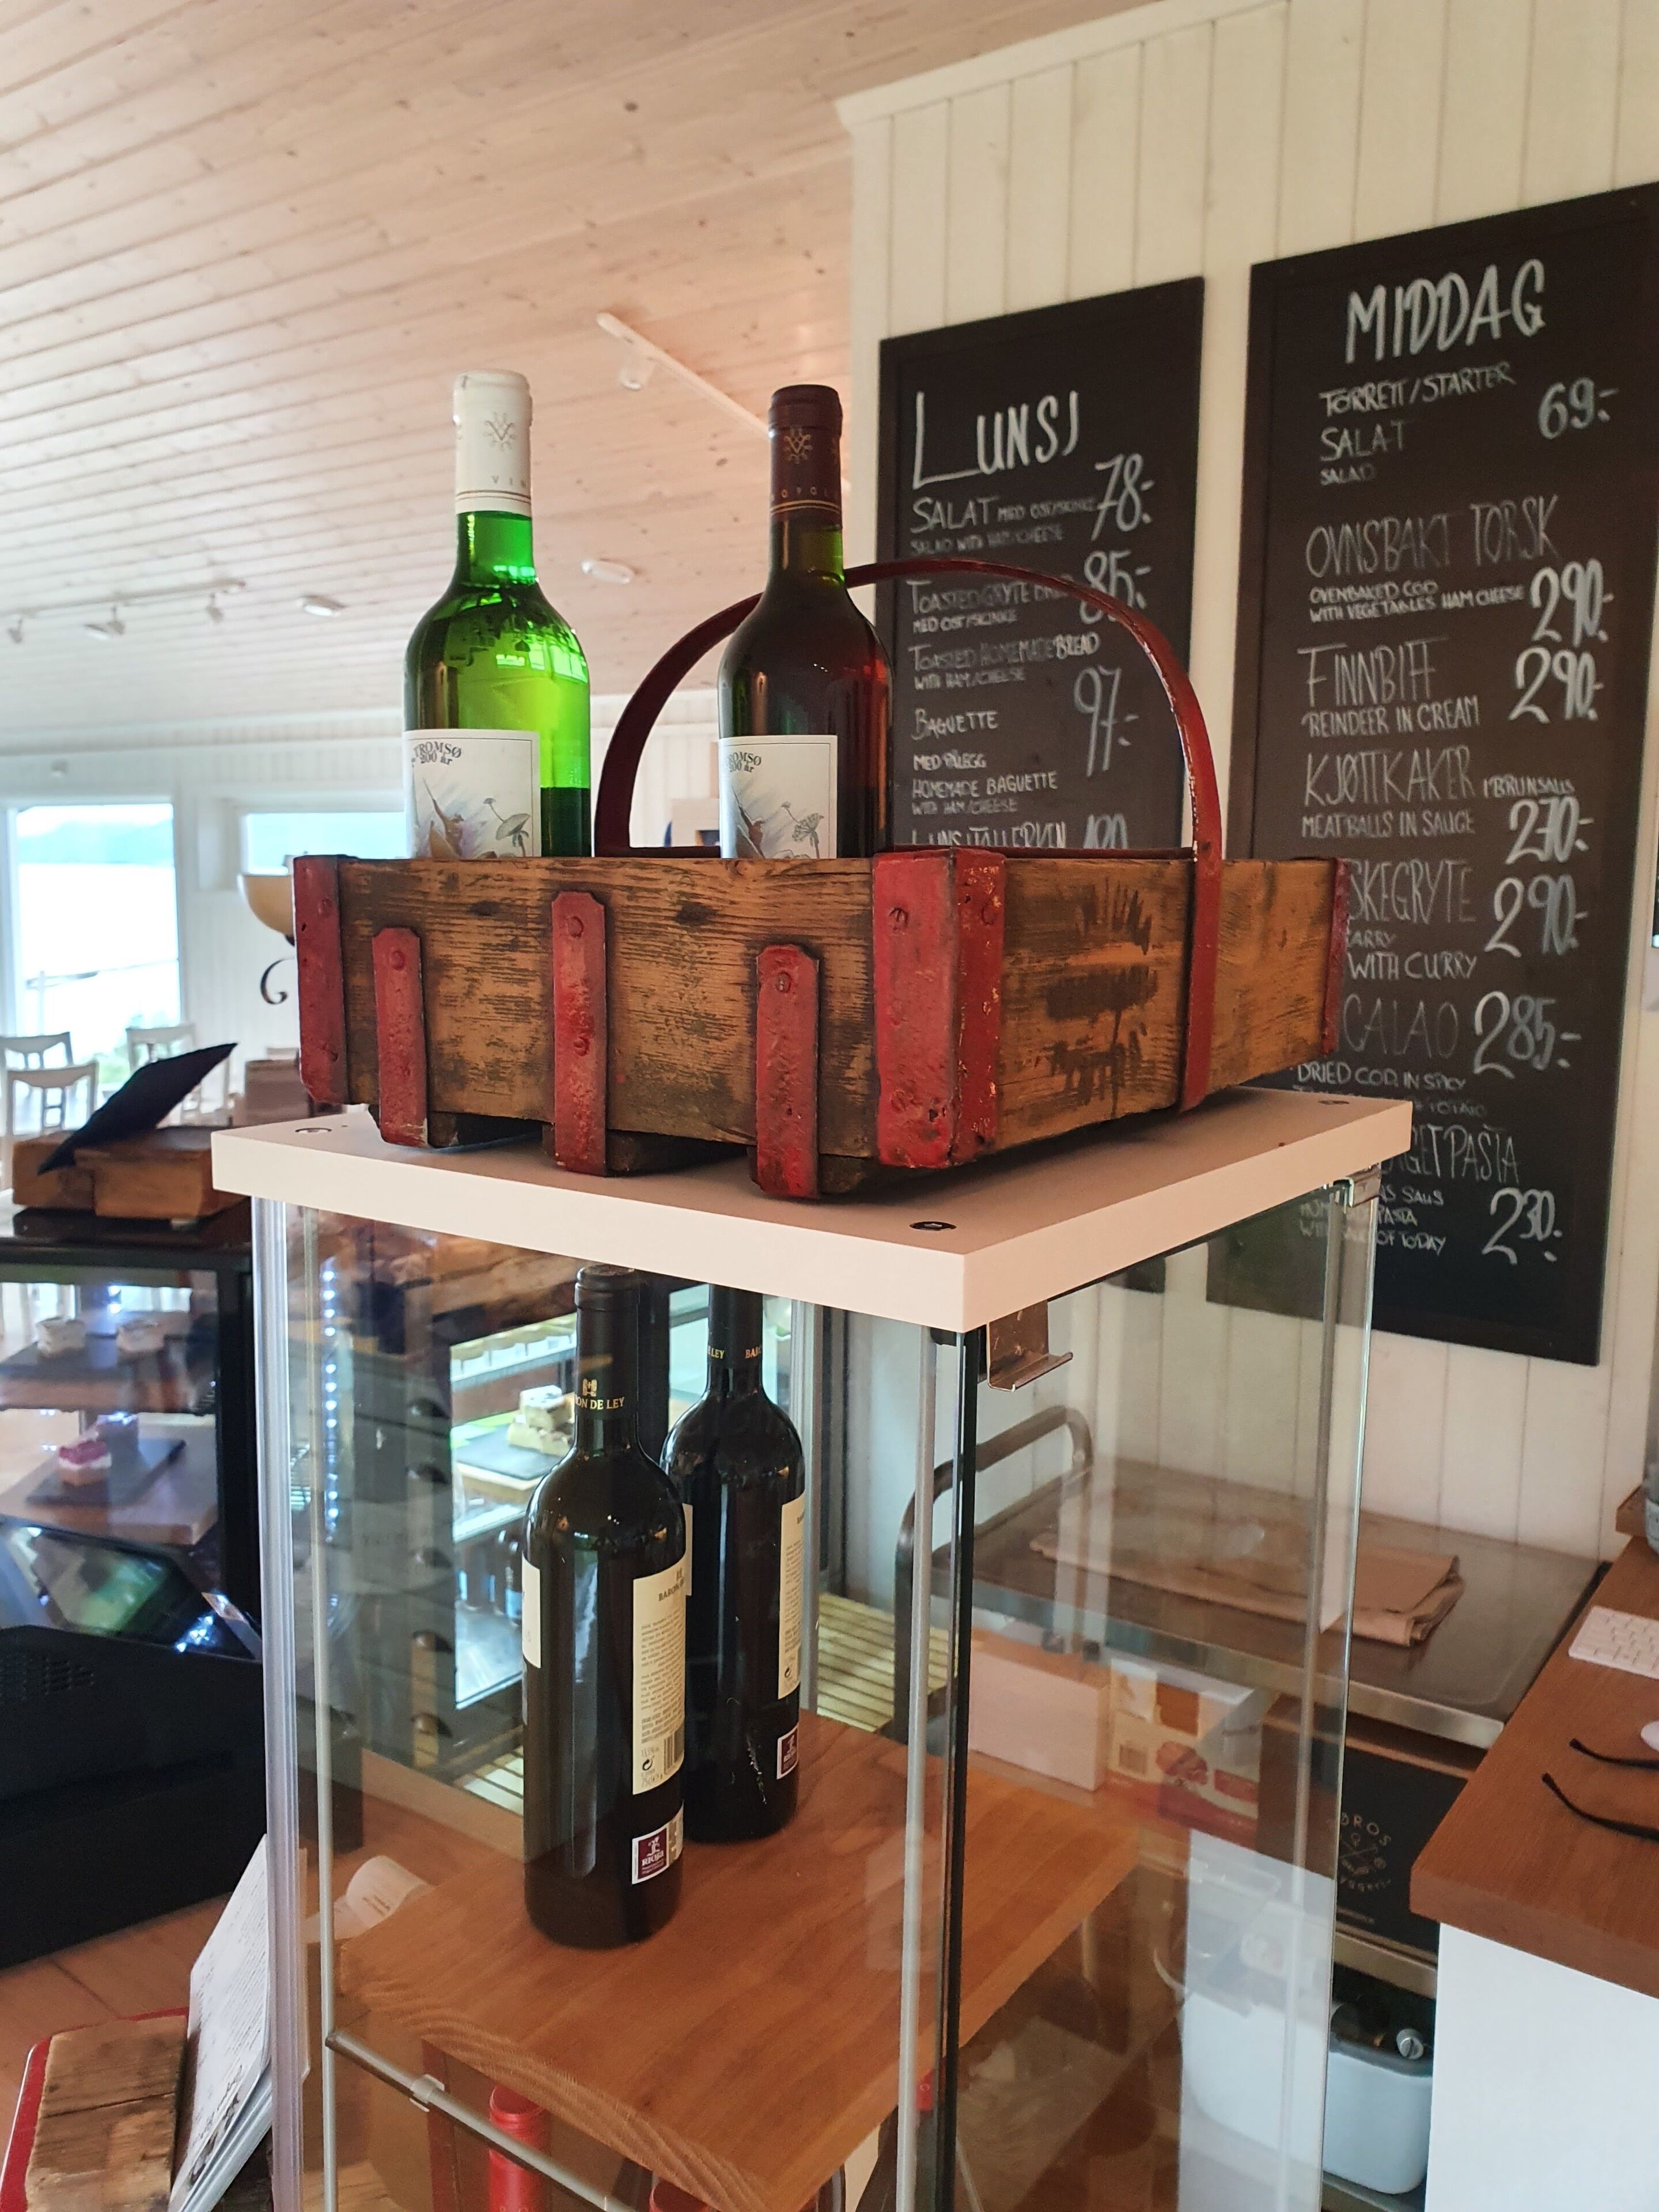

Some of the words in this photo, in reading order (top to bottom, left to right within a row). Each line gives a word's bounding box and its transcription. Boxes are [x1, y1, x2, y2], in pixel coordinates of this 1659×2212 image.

[1346, 259, 1546, 364] MIDDAG
[912, 390, 1080, 490] LUNSJ
[1320, 420, 1406, 461] SALAT
[1320, 463, 1374, 486] SALAD
[910, 495, 999, 535] SALAT
[1469, 494, 1560, 567] TORSK
[1297, 638, 1449, 708] FINNBIFF
[911, 707, 999, 741] BAGUETTE
[1301, 707, 1389, 738] REINDEER
[1396, 706, 1414, 733] IN
[1417, 695, 1480, 732] CREAM
[986, 770, 1059, 796] BAGUETTE
[1400, 811, 1417, 837] IN
[1423, 808, 1476, 837] SAUCE
[1347, 950, 1400, 980] WITH
[1404, 951, 1478, 980] CURRY
[1297, 1060, 1352, 1086] DRIED
[1355, 1067, 1399, 1088] COD
[1403, 1070, 1419, 1090] IN
[1402, 1185, 1444, 1208] SAUS
[1397, 1230, 1447, 1257] TODAY
[590, 1399, 604, 1410] DE
[607, 1396, 625, 1409] LEY
